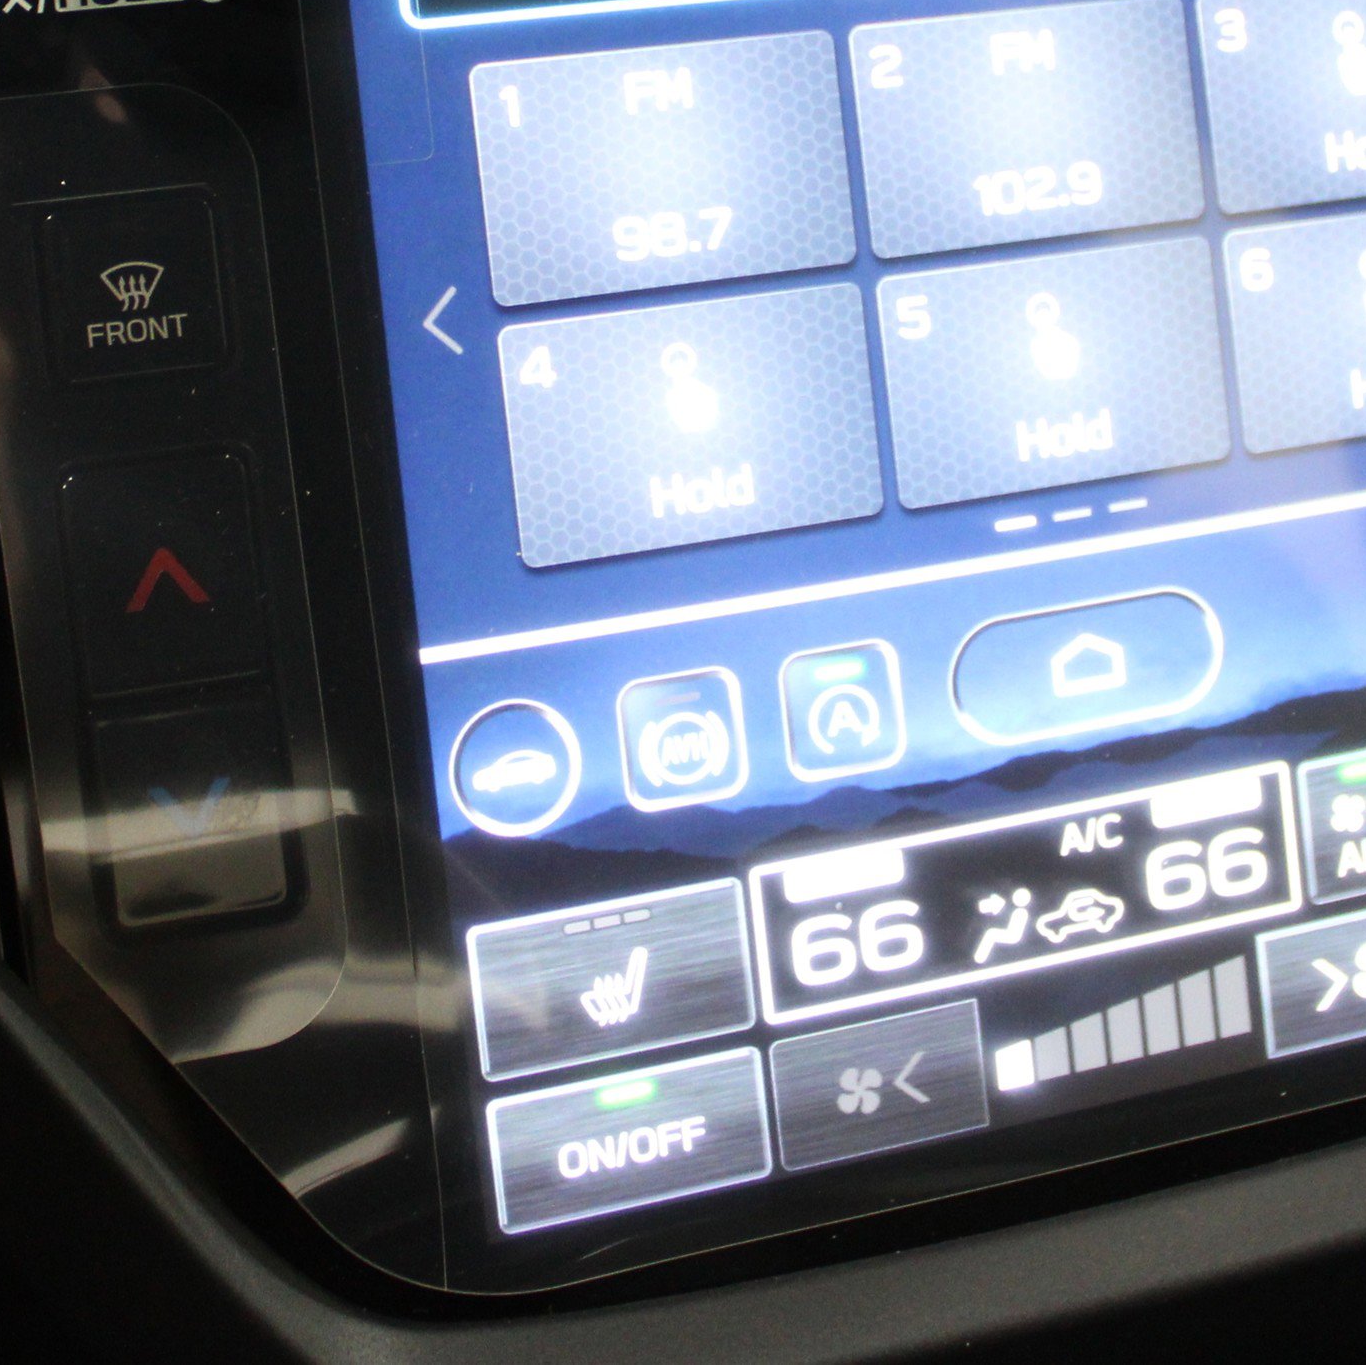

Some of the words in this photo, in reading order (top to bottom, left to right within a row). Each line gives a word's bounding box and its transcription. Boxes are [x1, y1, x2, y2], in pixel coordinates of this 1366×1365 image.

[1213, 9, 1249, 54] 3
[869, 45, 904, 89] 2
[989, 30, 1058, 75] FM
[499, 86, 522, 127] 1
[623, 68, 694, 114] FM
[973, 161, 1102, 216] 102.9
[1239, 247, 1275, 292] 6
[86, 313, 187, 349] FRONT
[894, 297, 931, 339] 5
[519, 347, 556, 388] 4
[1016, 410, 1112, 461] Hold
[650, 465, 754, 518] Hold
[1060, 812, 1122, 855] A/C
[1144, 832, 1269, 909] 66
[790, 903, 924, 986] 66
[557, 1117, 706, 1179] ON/OFF
